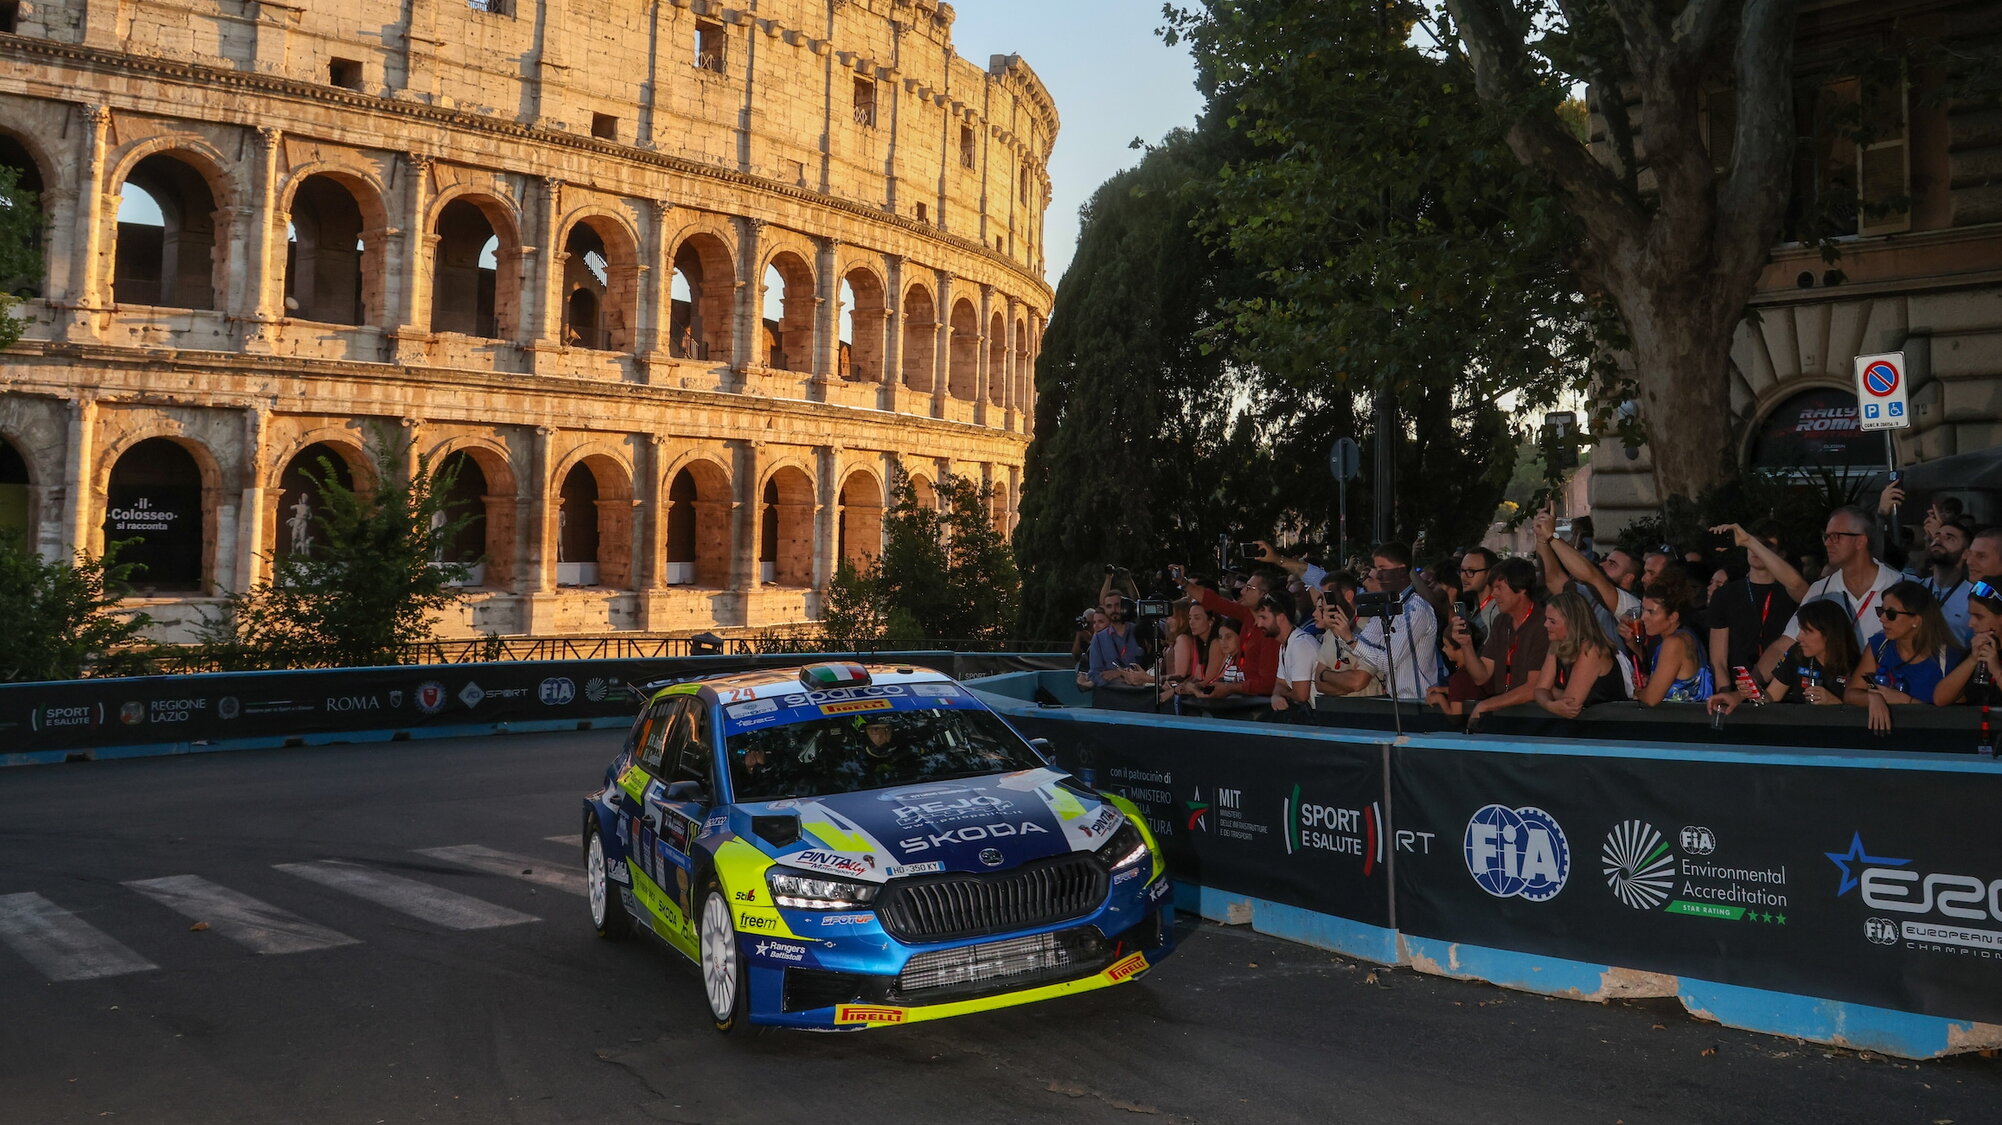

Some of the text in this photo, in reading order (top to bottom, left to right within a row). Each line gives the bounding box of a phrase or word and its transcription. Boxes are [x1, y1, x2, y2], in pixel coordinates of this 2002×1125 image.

[1800, 407, 1858, 419] RALLY
[1867, 405, 1877, 417] P
[111, 508, 174, 520] Colosseo
[116, 521, 168, 531] si racconta
[485, 687, 529, 698] SPORT
[729, 687, 756, 701] 24
[784, 684, 905, 706] sparco
[46, 706, 90, 718] SPORT
[151, 699, 206, 711] REGIONE
[326, 696, 380, 712] ROMA
[827, 699, 885, 713] PIRELLI
[53, 717, 90, 726] SALUTE
[151, 711, 189, 723] LAZIO
[1110, 767, 1172, 784] con il patrocinio di
[1131, 786, 1172, 804] MINISTERO
[1219, 787, 1241, 809] MIT
[1301, 803, 1361, 833] SPORT
[1147, 817, 1173, 836] TURA
[899, 821, 1049, 854] SKODA
[1302, 830, 1362, 856] E SALUTE
[799, 850, 853, 867] PINTA
[1682, 859, 1786, 885] Environmental
[1682, 880, 1788, 907] Accreditation
[1861, 867, 2002, 923] ER
[1682, 904, 1731, 916] STAR RATING
[739, 912, 777, 930] freem
[821, 914, 875, 926] SPOTUP
[1906, 926, 1993, 944] EUROPEAN
[769, 941, 806, 954] Rangers
[1109, 956, 1146, 981] PIRELLI
[841, 1007, 902, 1022] PIRELLI
